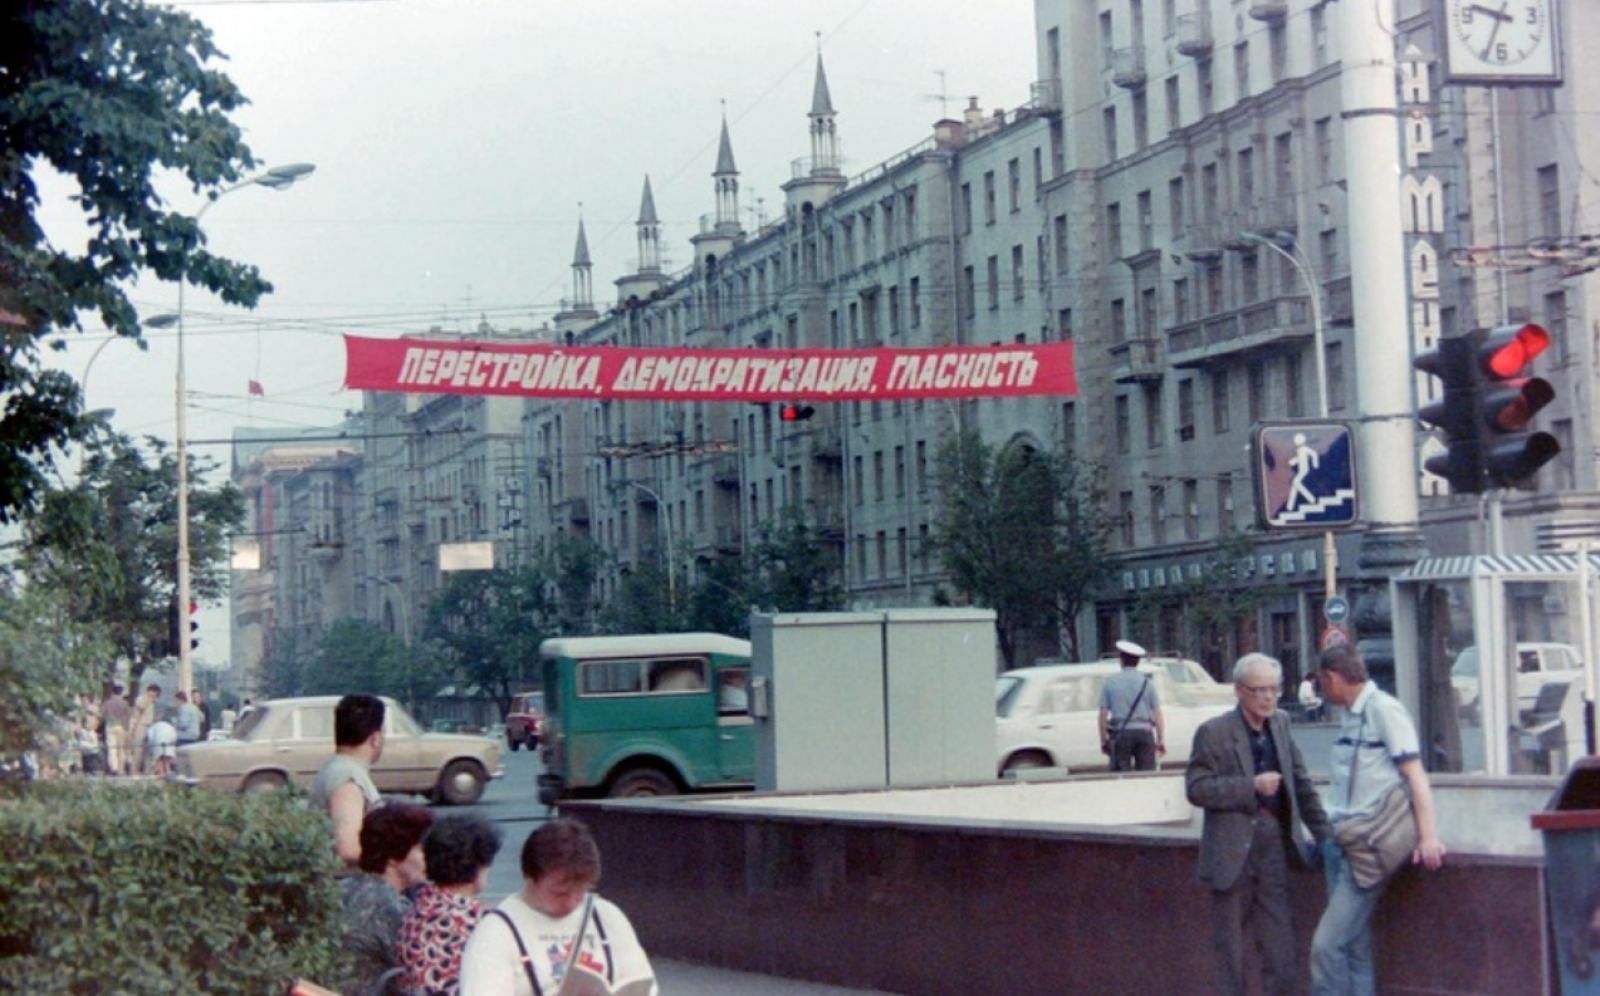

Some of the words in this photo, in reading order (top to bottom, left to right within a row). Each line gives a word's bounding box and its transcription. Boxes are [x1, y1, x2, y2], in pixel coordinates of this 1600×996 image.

[1462, 7, 1473, 24] 9
[1526, 7, 1537, 24] 3
[1496, 43, 1508, 60] 6
[397, 347, 603, 394] ПЕРЕСТРОЙКА,
[612, 356, 877, 394] ДЕМОКРАТИЗАЦИЯ,
[886, 350, 1039, 390] ГЛАСНОСТЬ
